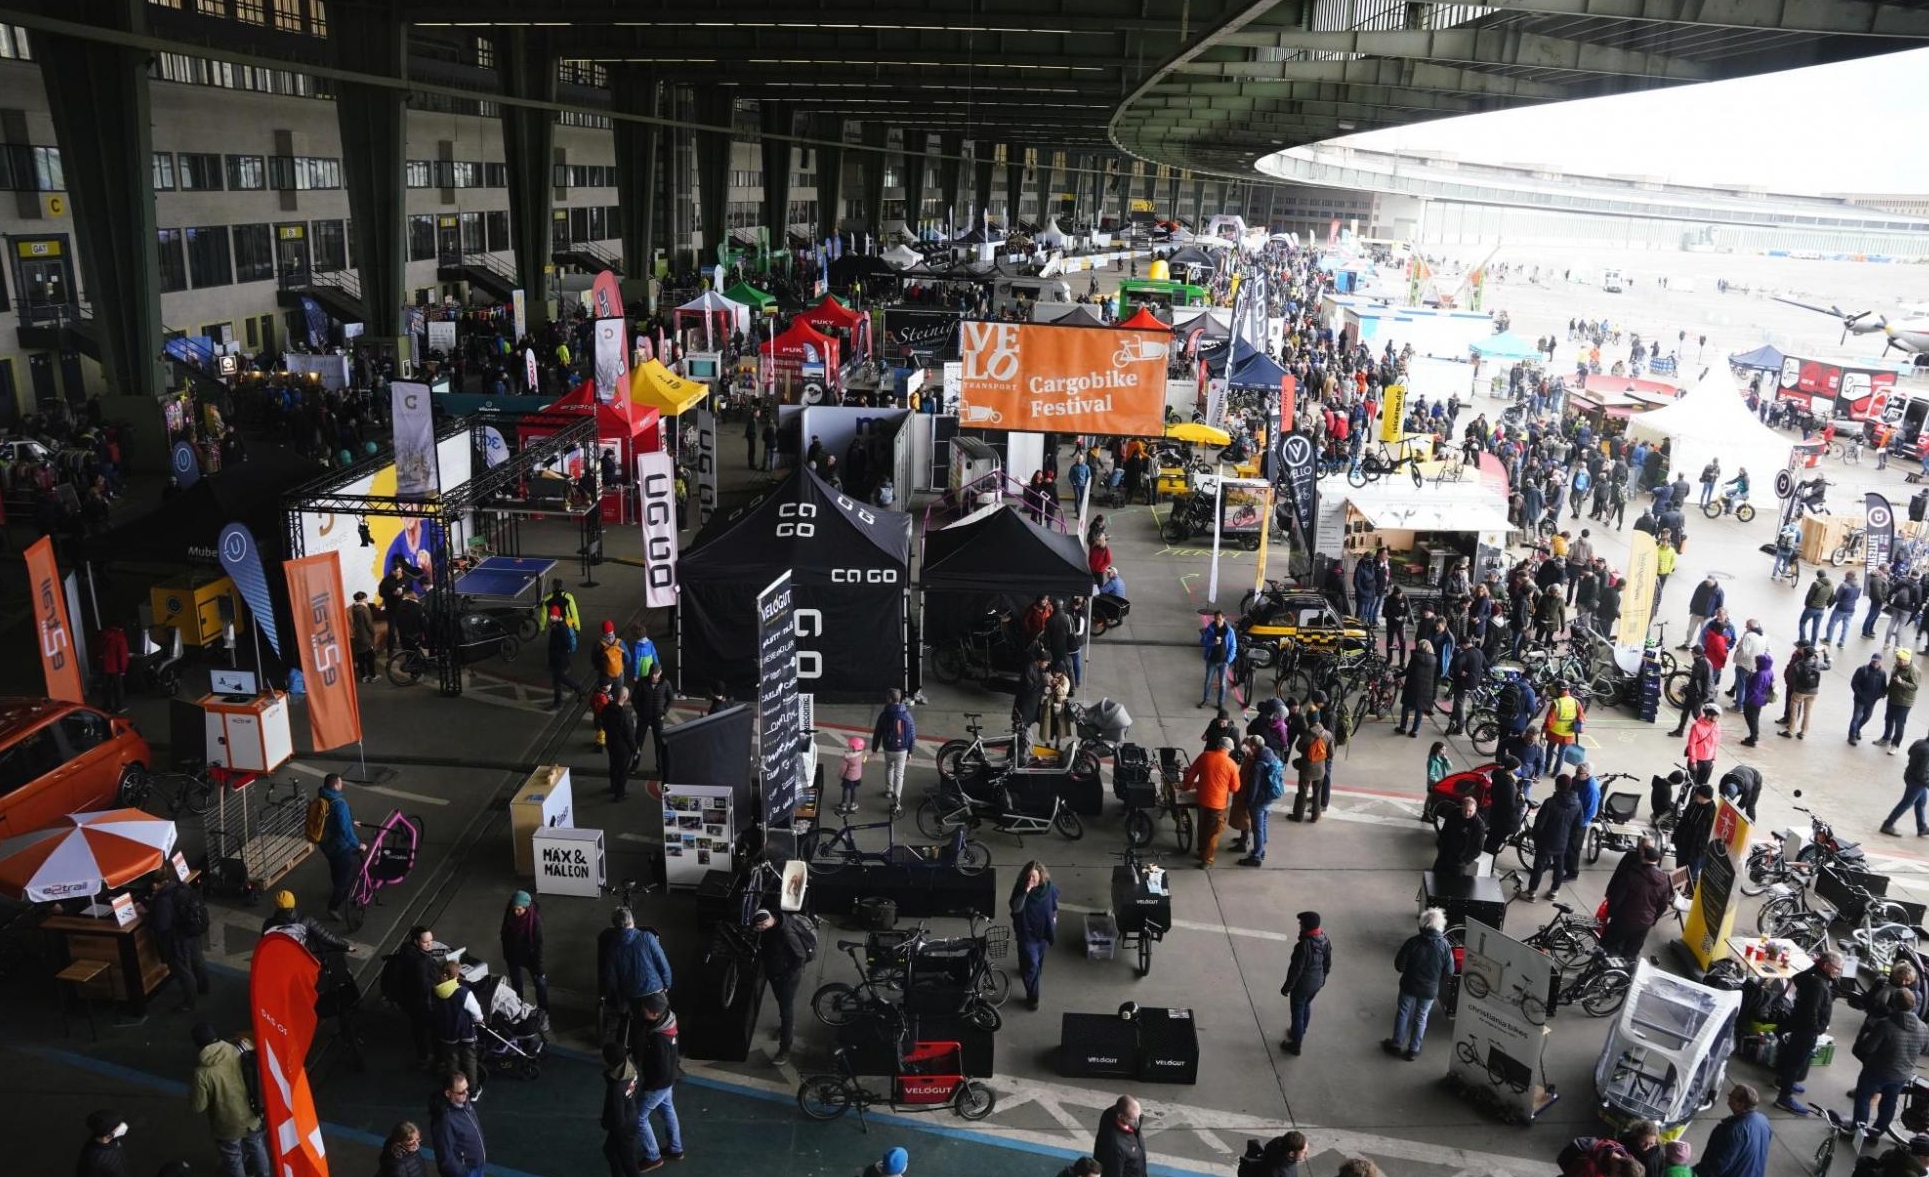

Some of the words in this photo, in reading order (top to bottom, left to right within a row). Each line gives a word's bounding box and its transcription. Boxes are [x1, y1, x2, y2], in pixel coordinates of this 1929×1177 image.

[964, 382, 1018, 390] TRANSPORT
[1029, 370, 1138, 395] Cargobike
[1031, 394, 1113, 418] Festival
[1288, 466, 1312, 480] VELLO
[776, 522, 815, 537] GO
[188, 546, 218, 557] Mube
[867, 569, 897, 583] GO
[574, 849, 587, 864] &
[42, 881, 88, 895] e2trail
[905, 1086, 953, 1094] VELOGUT
